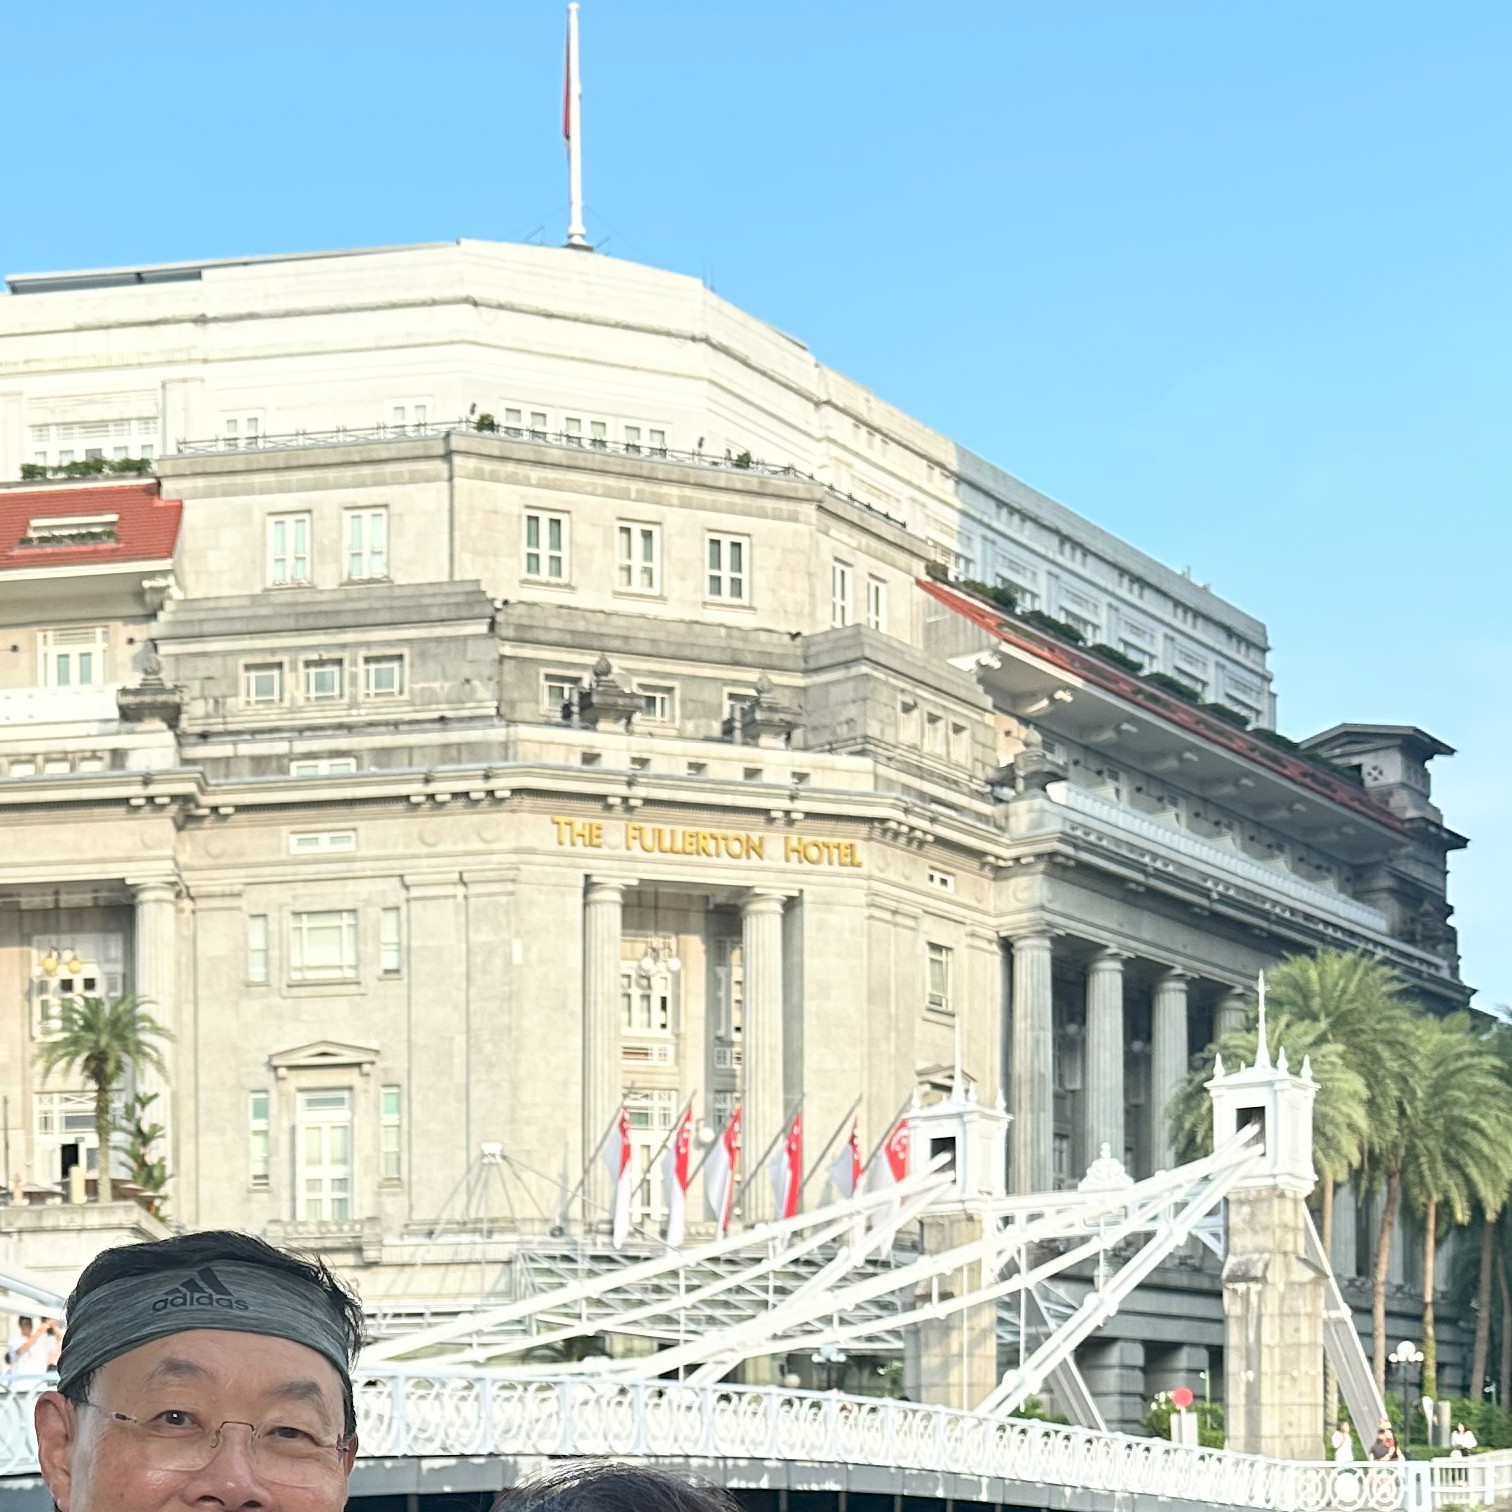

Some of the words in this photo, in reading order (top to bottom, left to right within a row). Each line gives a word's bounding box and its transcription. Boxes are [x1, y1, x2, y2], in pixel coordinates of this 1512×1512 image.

[552, 816, 602, 848] THE
[625, 823, 764, 860] FULLERTON
[784, 836, 862, 867] HOTEL
[152, 1293, 250, 1312] adidas
